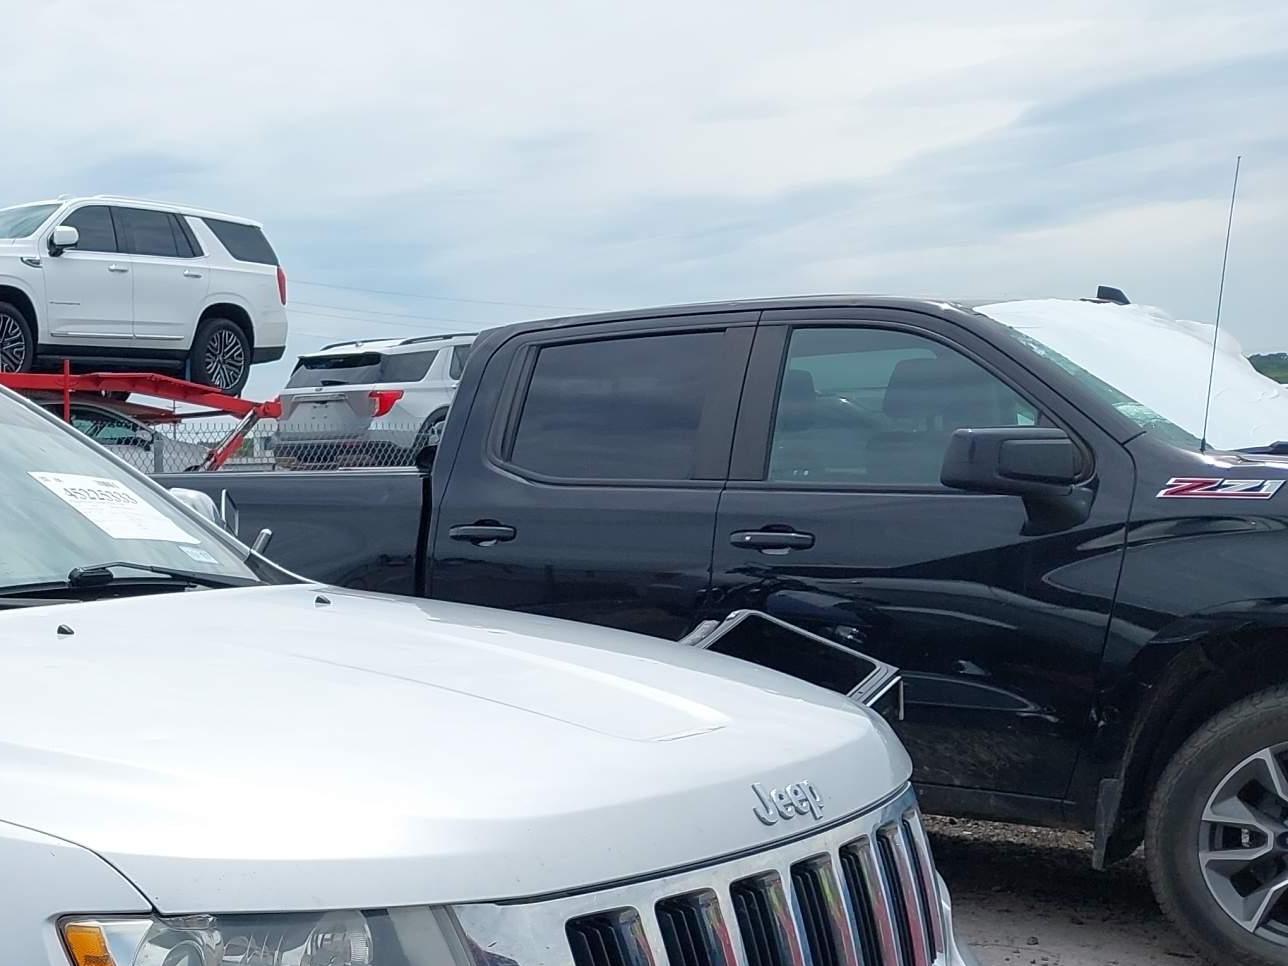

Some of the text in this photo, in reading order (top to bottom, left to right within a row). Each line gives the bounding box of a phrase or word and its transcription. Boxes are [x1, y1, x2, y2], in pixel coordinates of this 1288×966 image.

[63, 487, 138, 505] 45225333
[1156, 477, 1286, 500] Z71
[752, 779, 824, 826] Jeep
